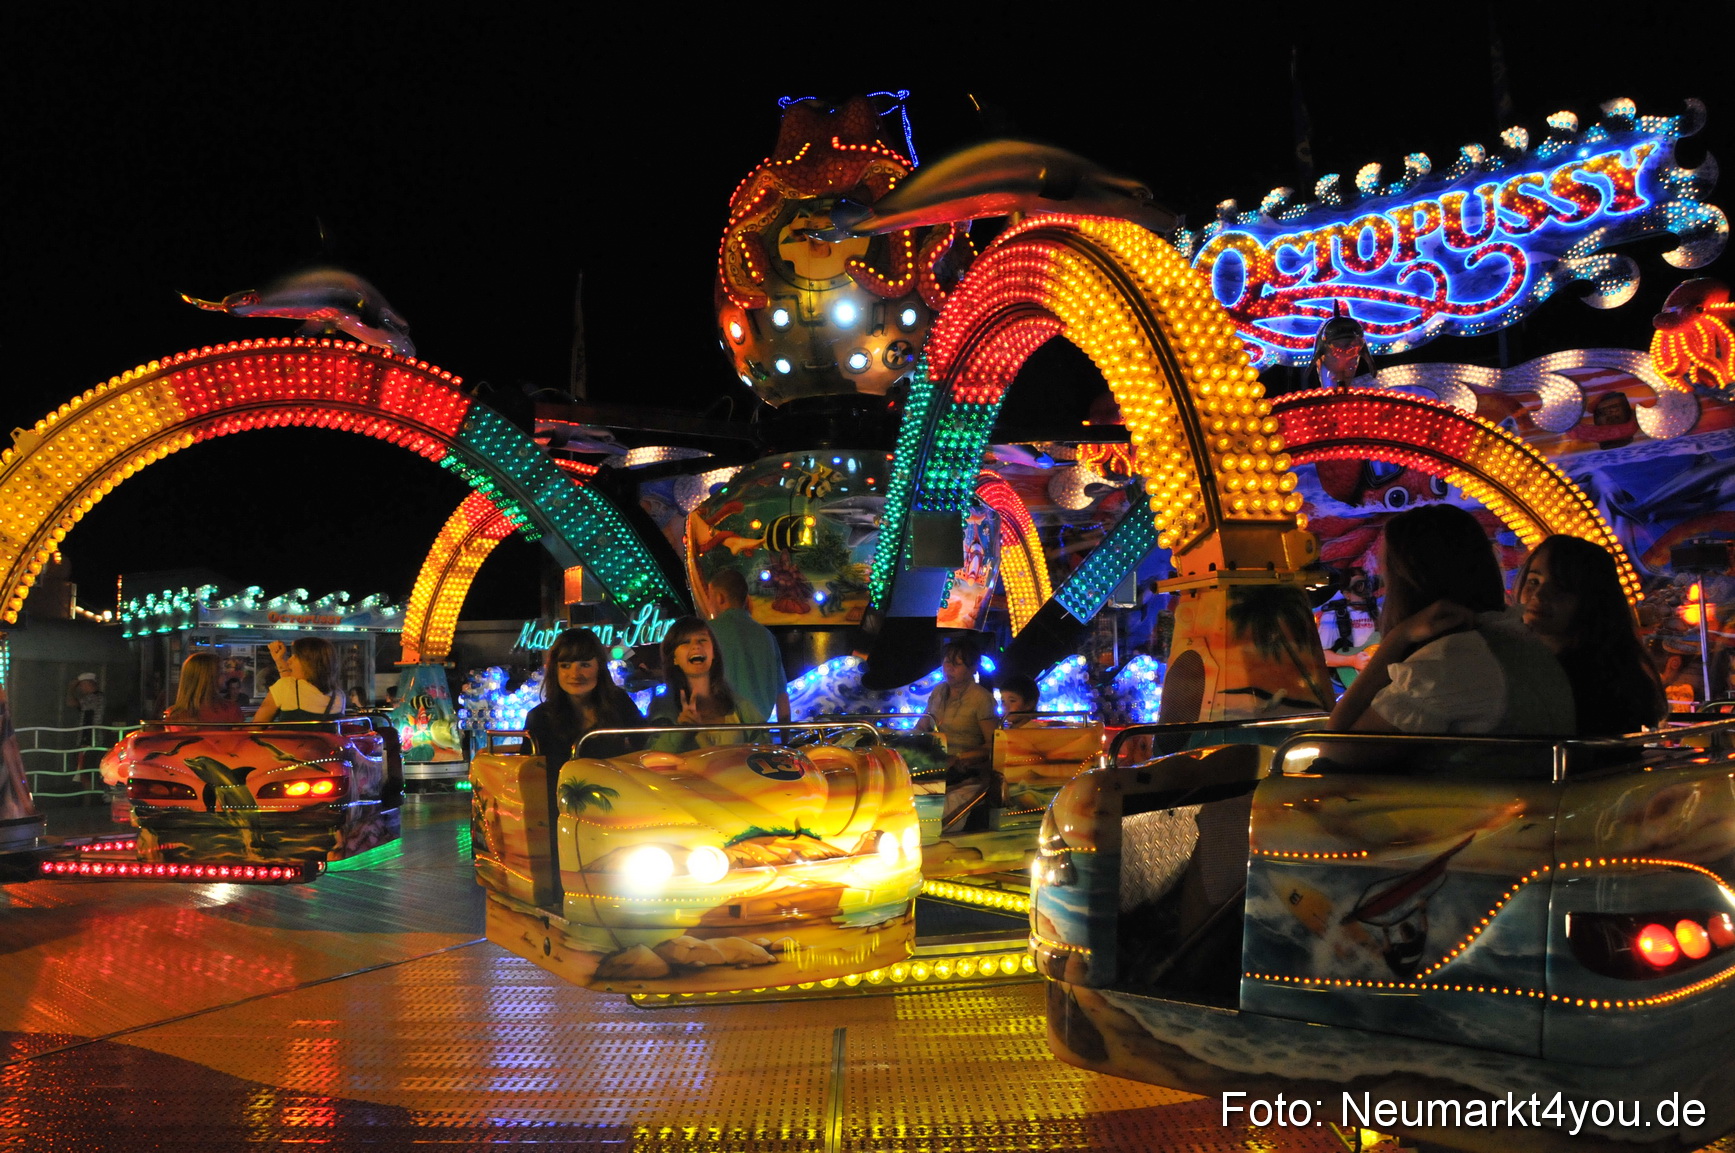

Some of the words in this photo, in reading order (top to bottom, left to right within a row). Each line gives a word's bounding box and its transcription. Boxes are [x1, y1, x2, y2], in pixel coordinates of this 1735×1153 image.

[1193, 138, 1660, 345] OCTOPUSSY
[267, 611, 343, 625] OCTOPUSSY
[752, 756, 801, 775] 13
